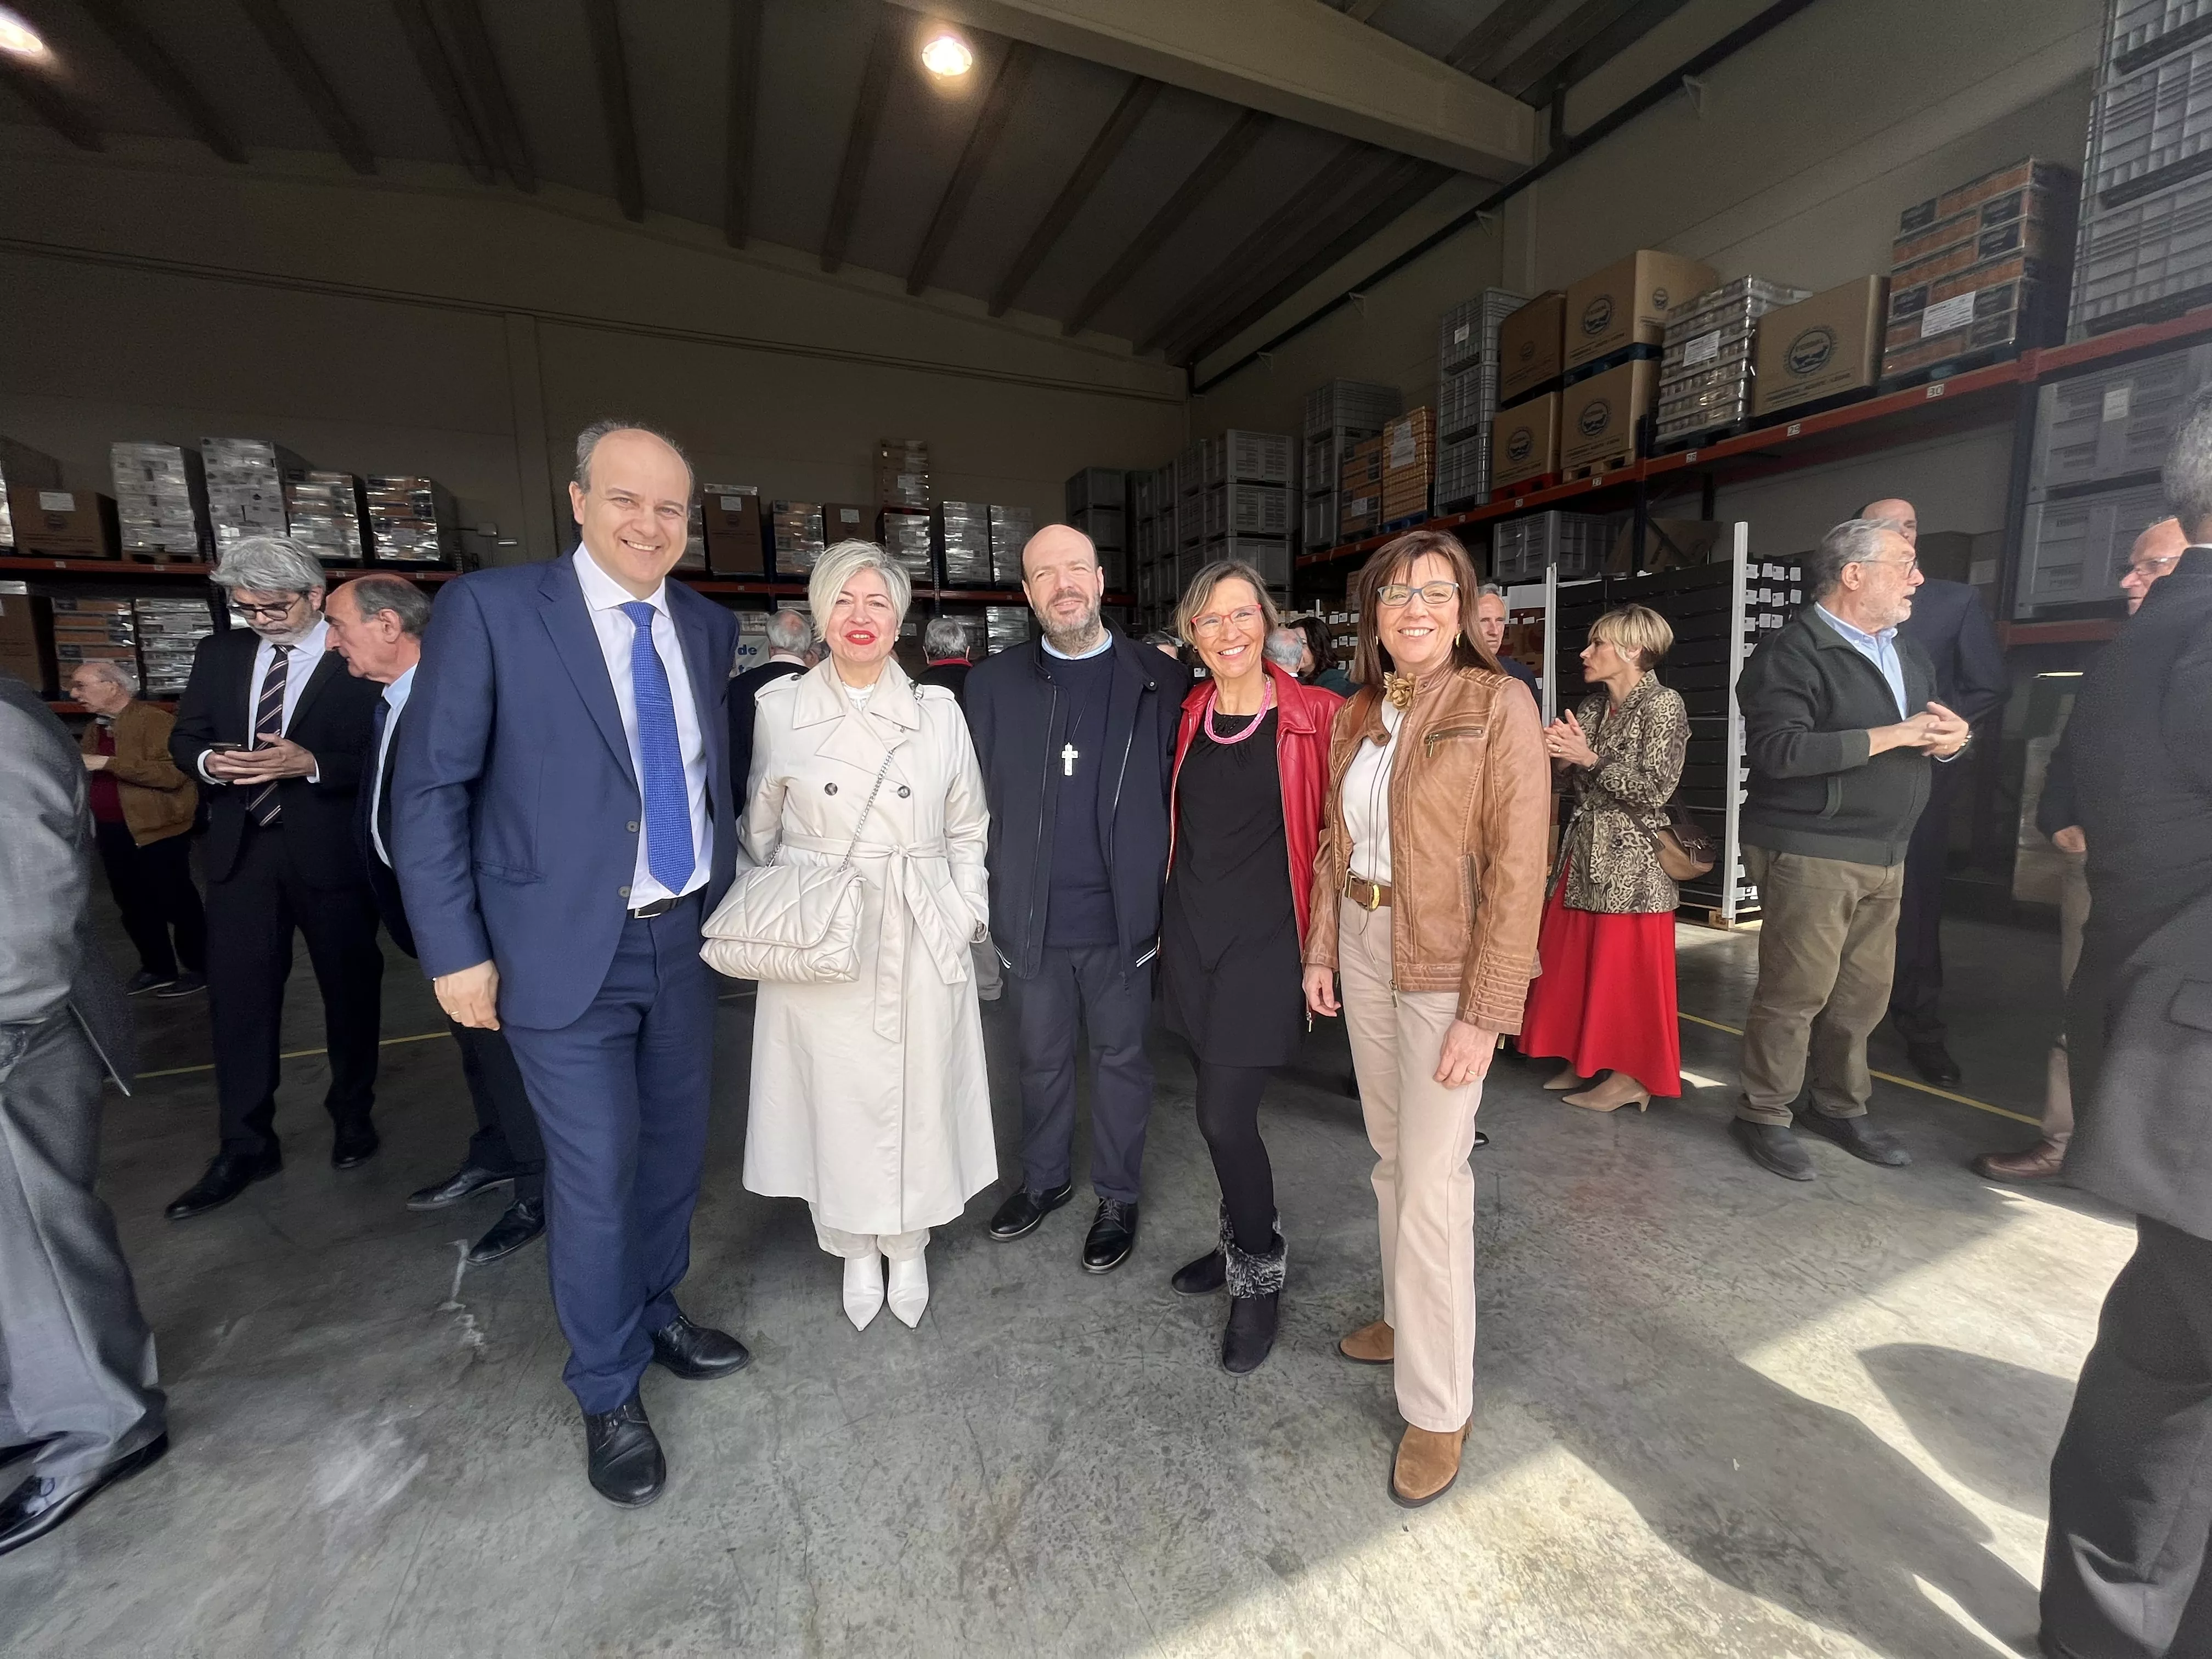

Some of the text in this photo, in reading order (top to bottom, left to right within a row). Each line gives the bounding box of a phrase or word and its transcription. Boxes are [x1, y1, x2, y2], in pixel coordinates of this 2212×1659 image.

[1928, 386, 1943, 397] 30
[1789, 425, 1800, 434] 29
[737, 644, 757, 655] de
